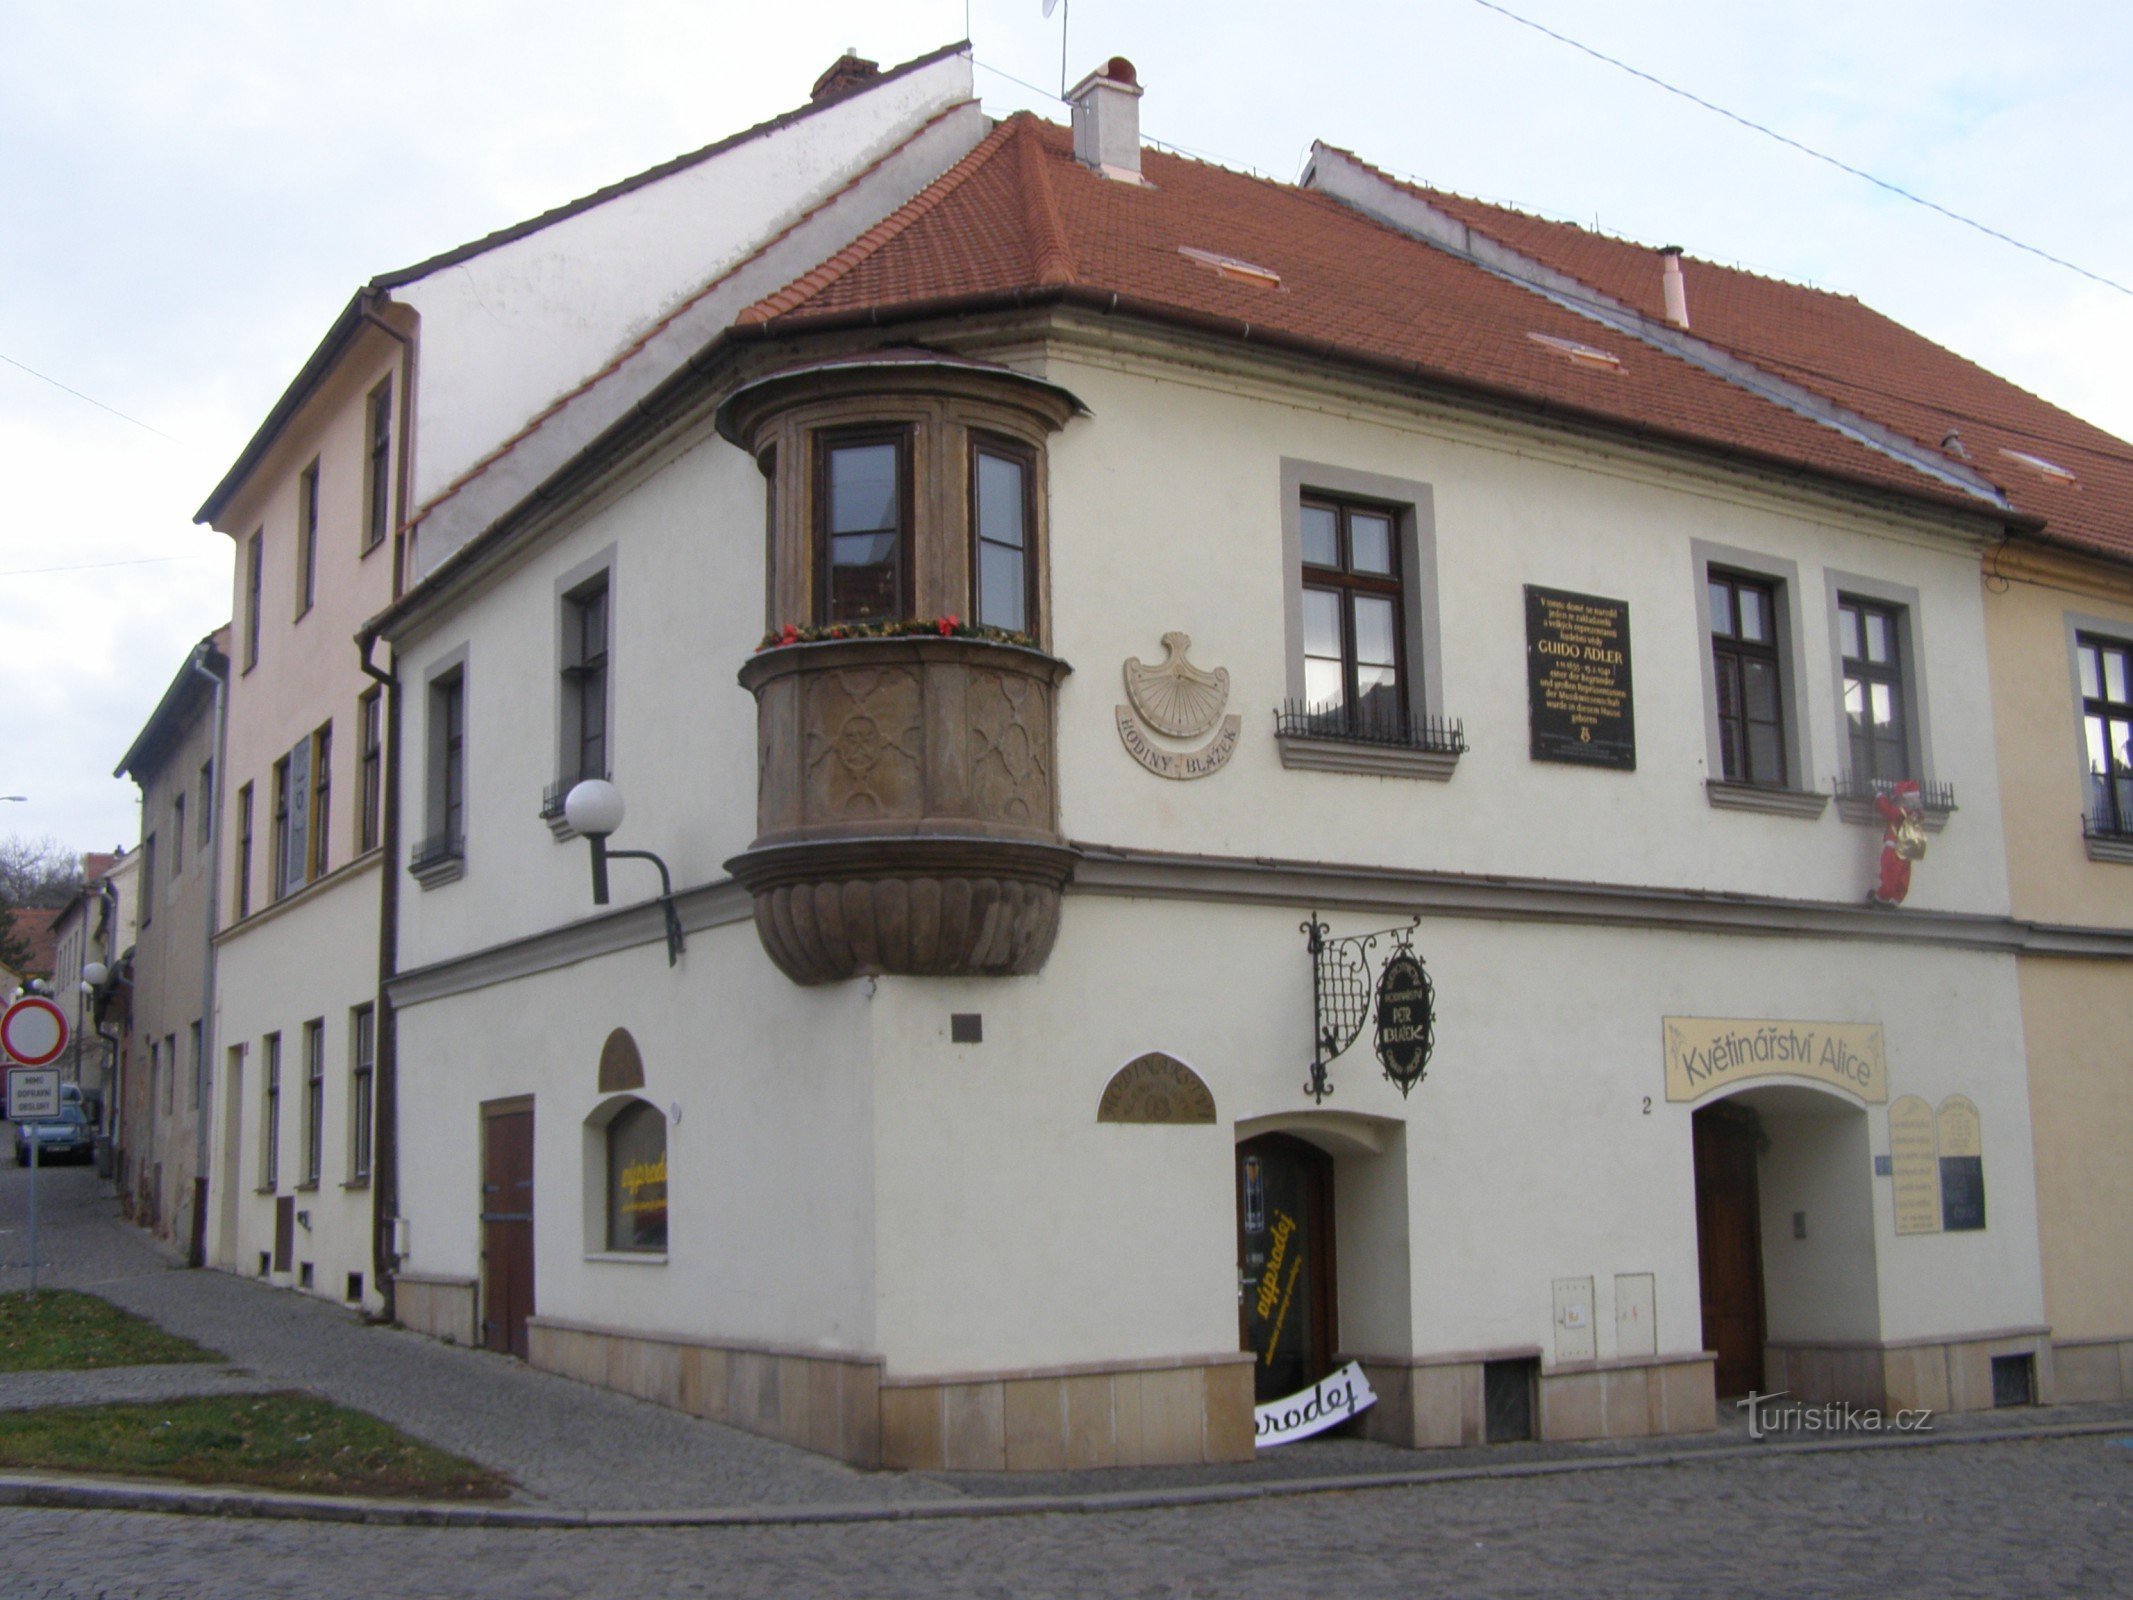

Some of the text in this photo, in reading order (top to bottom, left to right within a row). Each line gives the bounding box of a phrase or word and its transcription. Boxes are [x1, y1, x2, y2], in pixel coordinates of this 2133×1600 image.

[1538, 639, 1623, 664] GUIDO ADLER
[1121, 718, 1173, 772] HODINY
[1392, 1006, 1412, 1024] PETR
[1682, 1027, 1871, 1087] Květinářství Alice
[25, 1076, 44, 1085] MIMO
[1642, 1096, 1652, 1114] 2
[1257, 1209, 1297, 1320] výprodej
